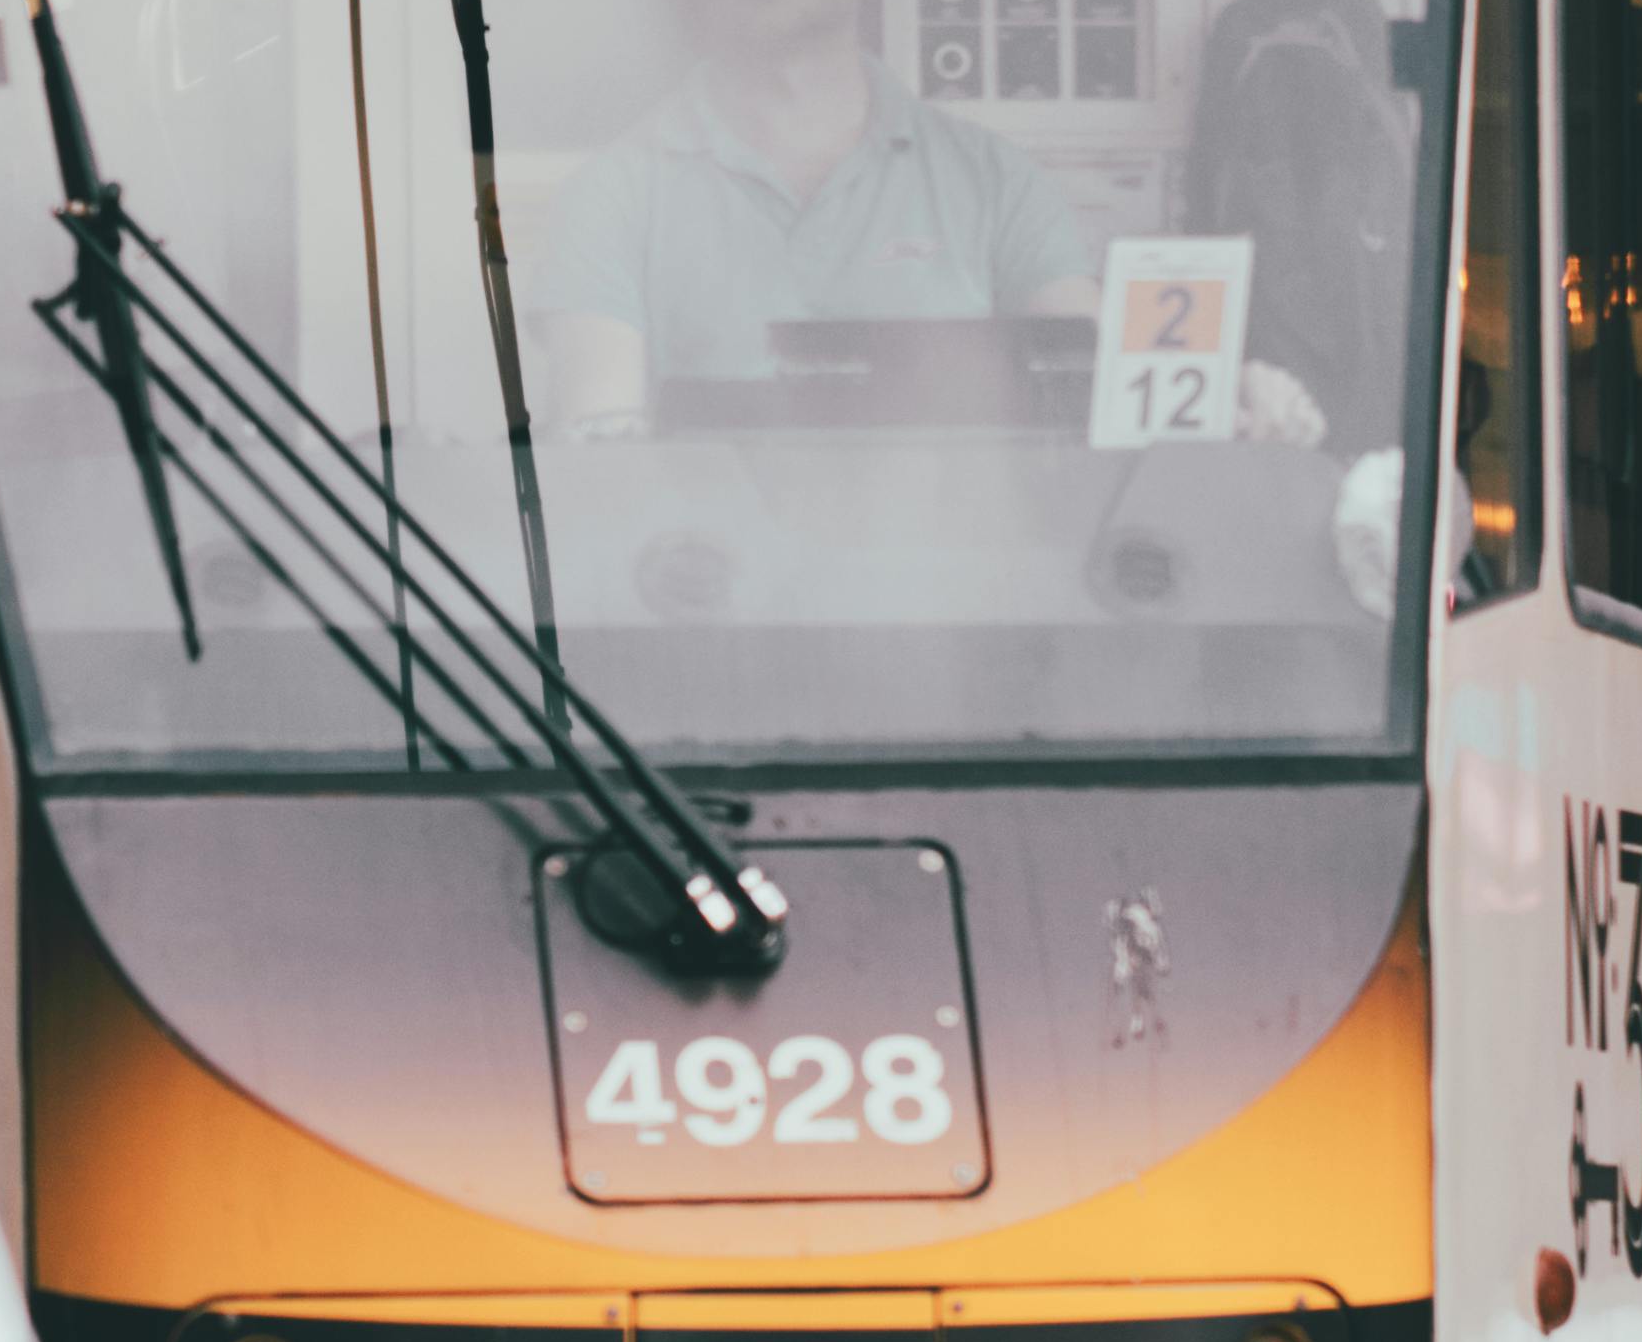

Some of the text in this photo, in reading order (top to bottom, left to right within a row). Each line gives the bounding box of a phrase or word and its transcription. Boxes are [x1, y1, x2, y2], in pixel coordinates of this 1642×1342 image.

[1154, 285, 1191, 348] 2
[1126, 367, 1207, 430] 12
[585, 1034, 952, 1146] 4928
